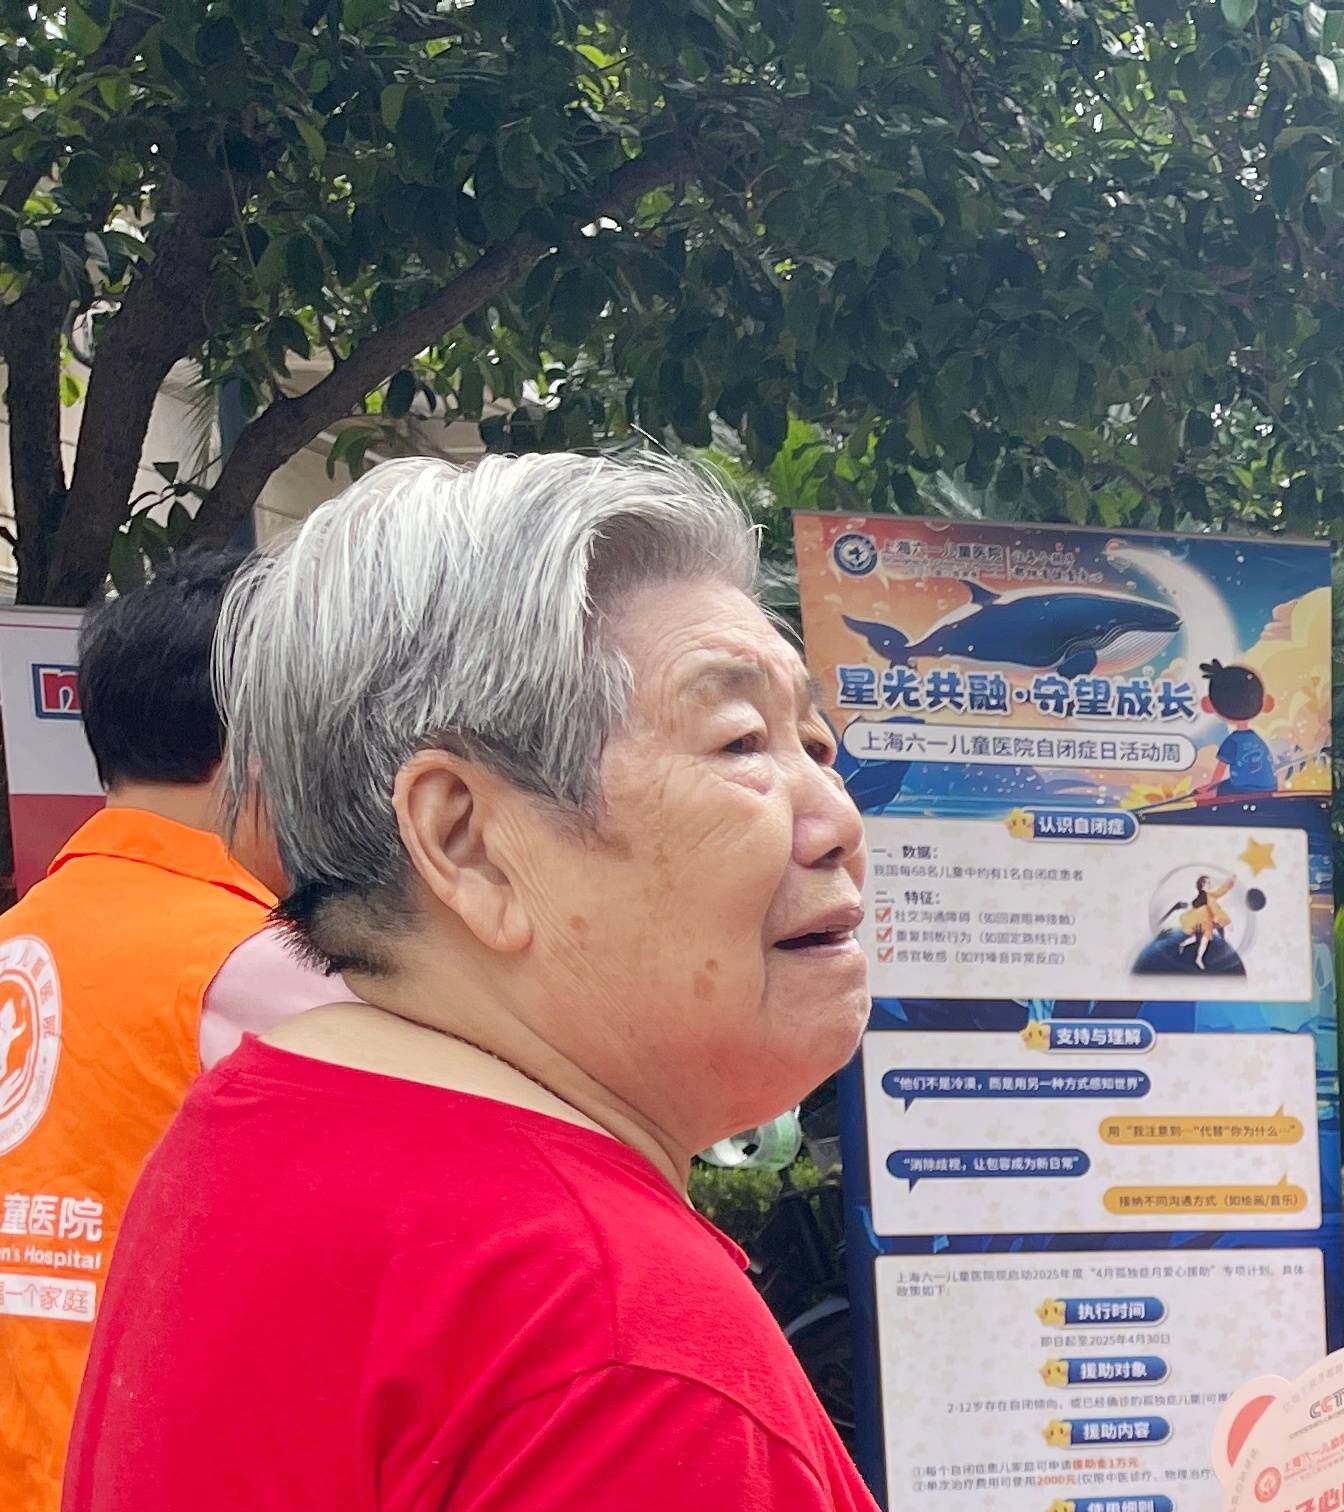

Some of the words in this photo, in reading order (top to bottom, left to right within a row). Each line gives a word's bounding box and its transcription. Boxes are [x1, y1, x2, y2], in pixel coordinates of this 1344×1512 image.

[838, 667, 1196, 721] 星光共融·守望成长
[860, 731, 1181, 763] 上海六一儿童医院自闭症日活动周
[1038, 815, 1125, 836] 认识自闭症
[1056, 1028, 1142, 1047] 支持与理解
[24, 1246, 102, 1270] Hospital
[1077, 1302, 1146, 1321] 执行时间
[1041, 1333, 1171, 1347] 即日起至2025年4月30日
[1080, 1361, 1147, 1380] 援助对象
[1082, 1422, 1151, 1440] 援助内容
